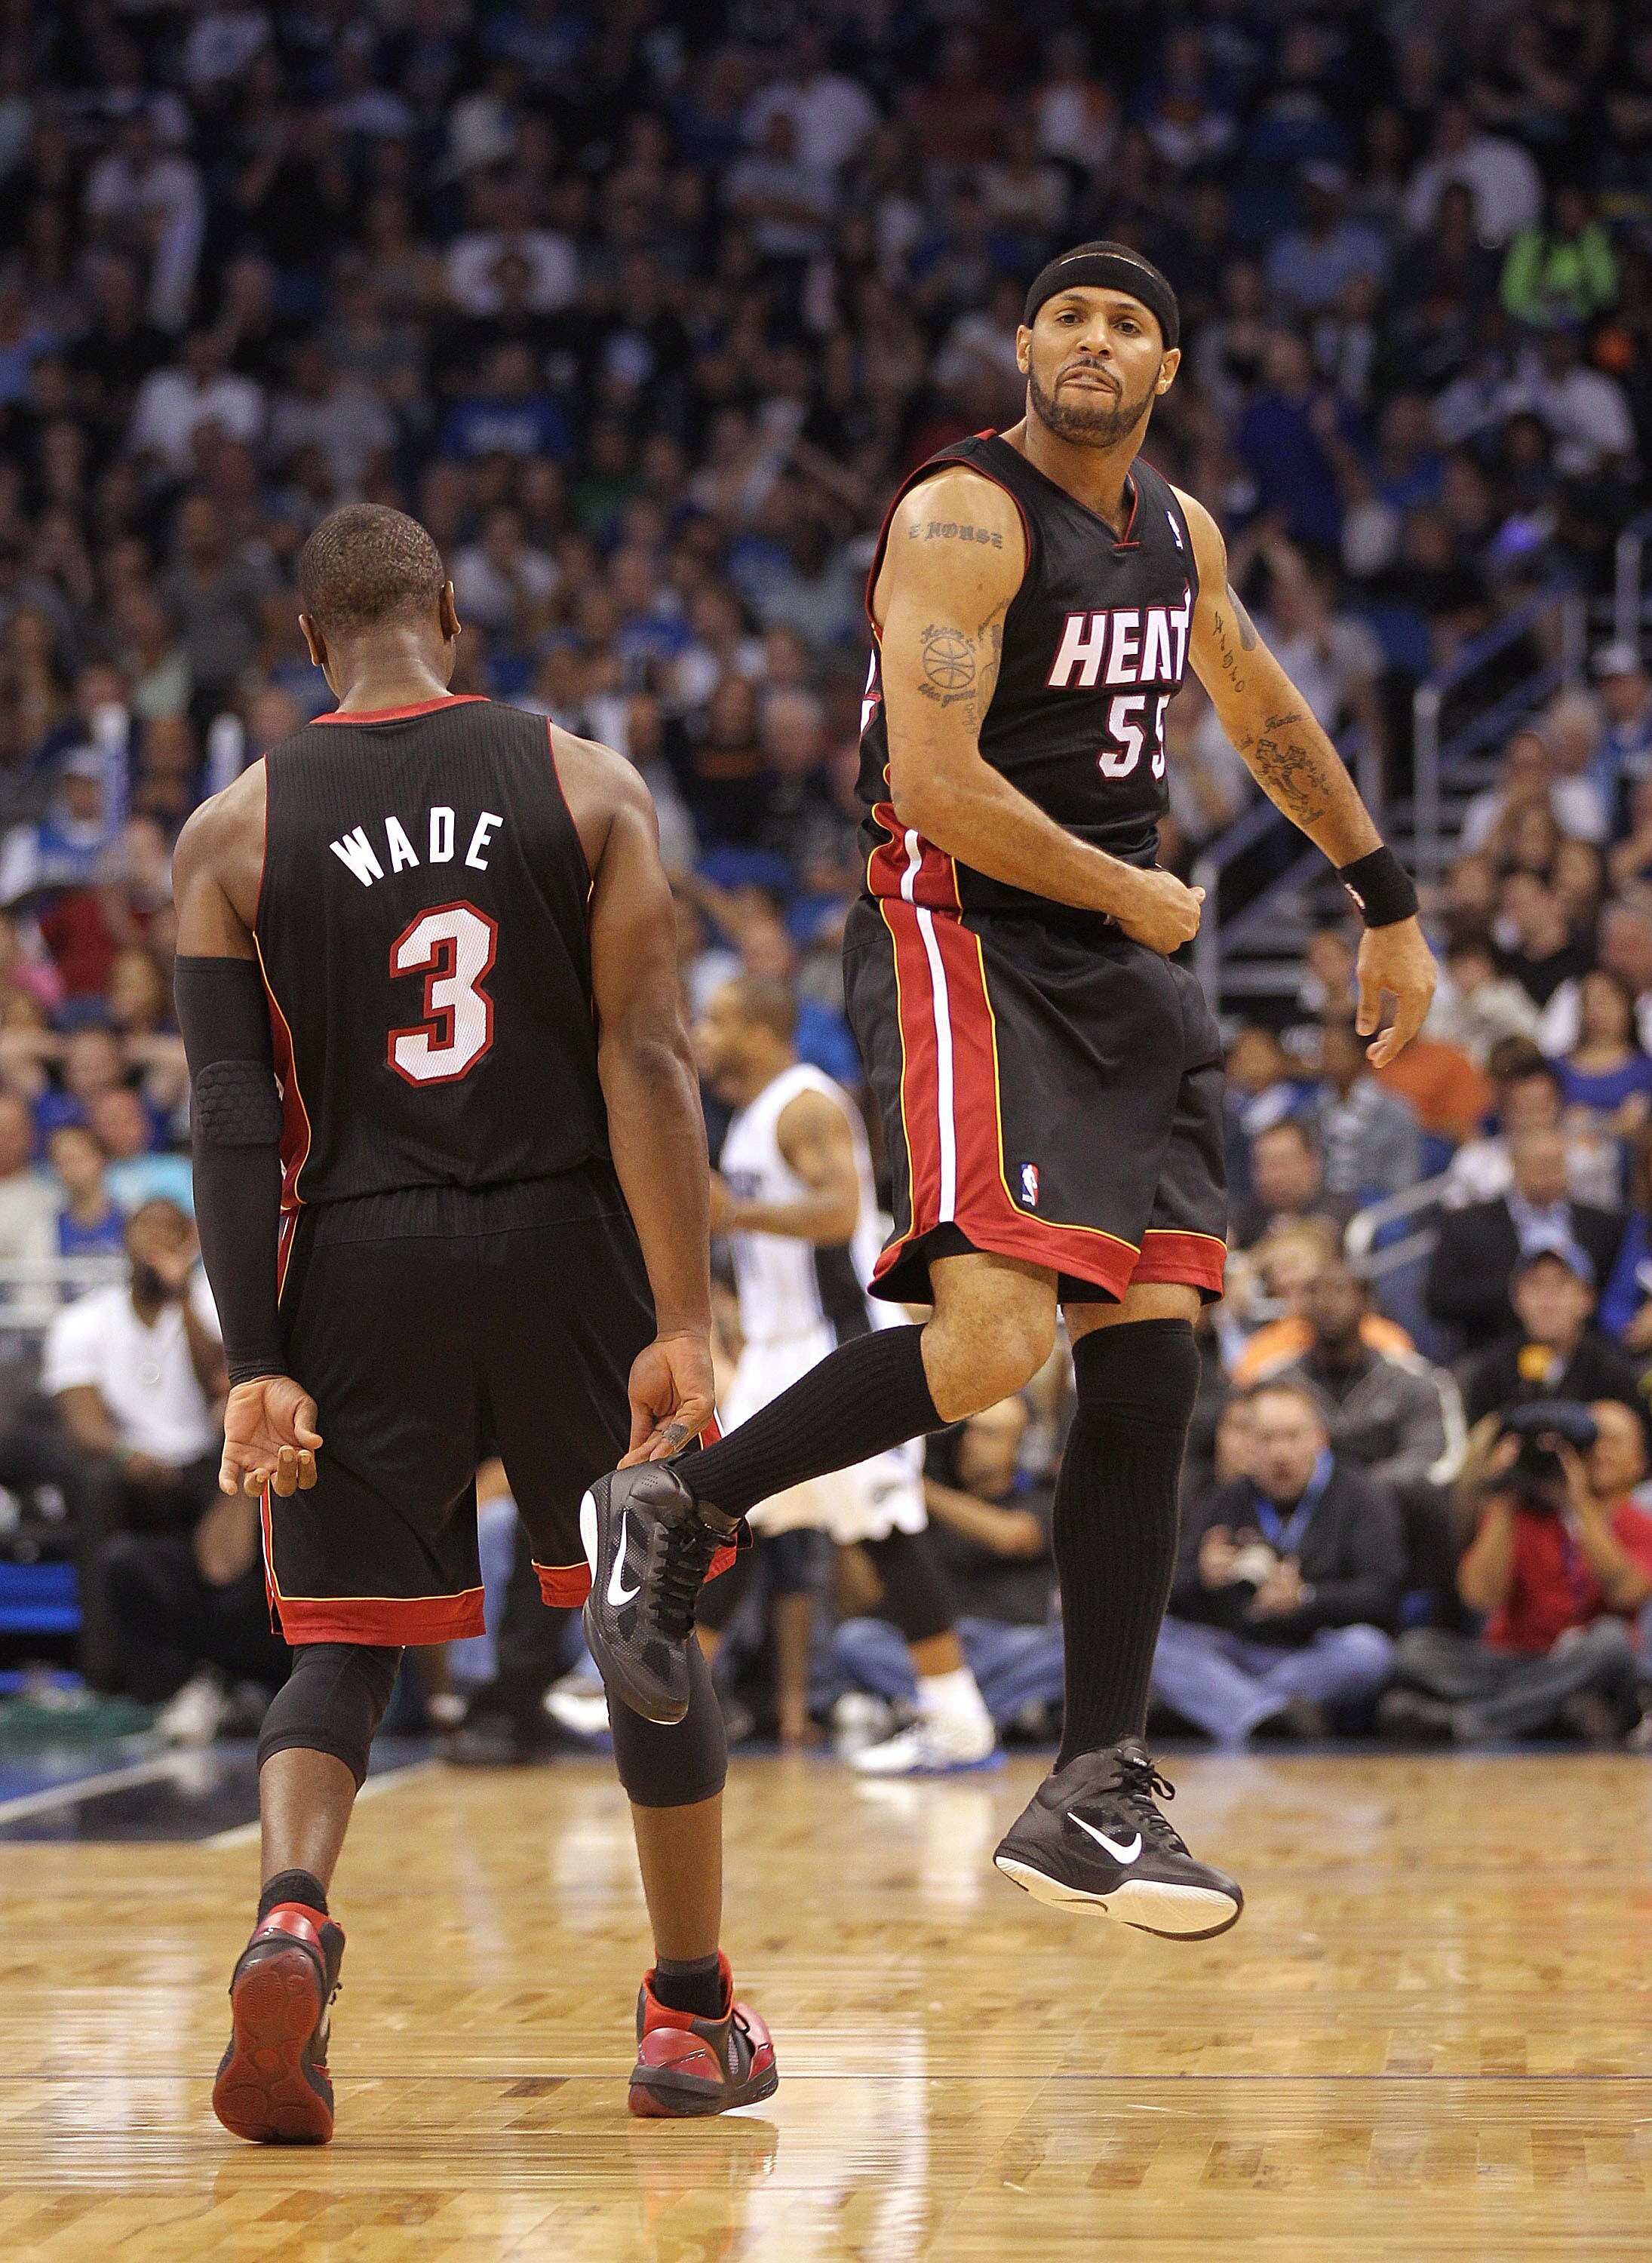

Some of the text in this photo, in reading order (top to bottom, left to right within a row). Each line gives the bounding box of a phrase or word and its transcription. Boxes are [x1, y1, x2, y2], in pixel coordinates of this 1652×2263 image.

[1045, 587, 1193, 689] HEAT
[329, 806, 503, 887] WADE
[386, 899, 499, 1088] 3
